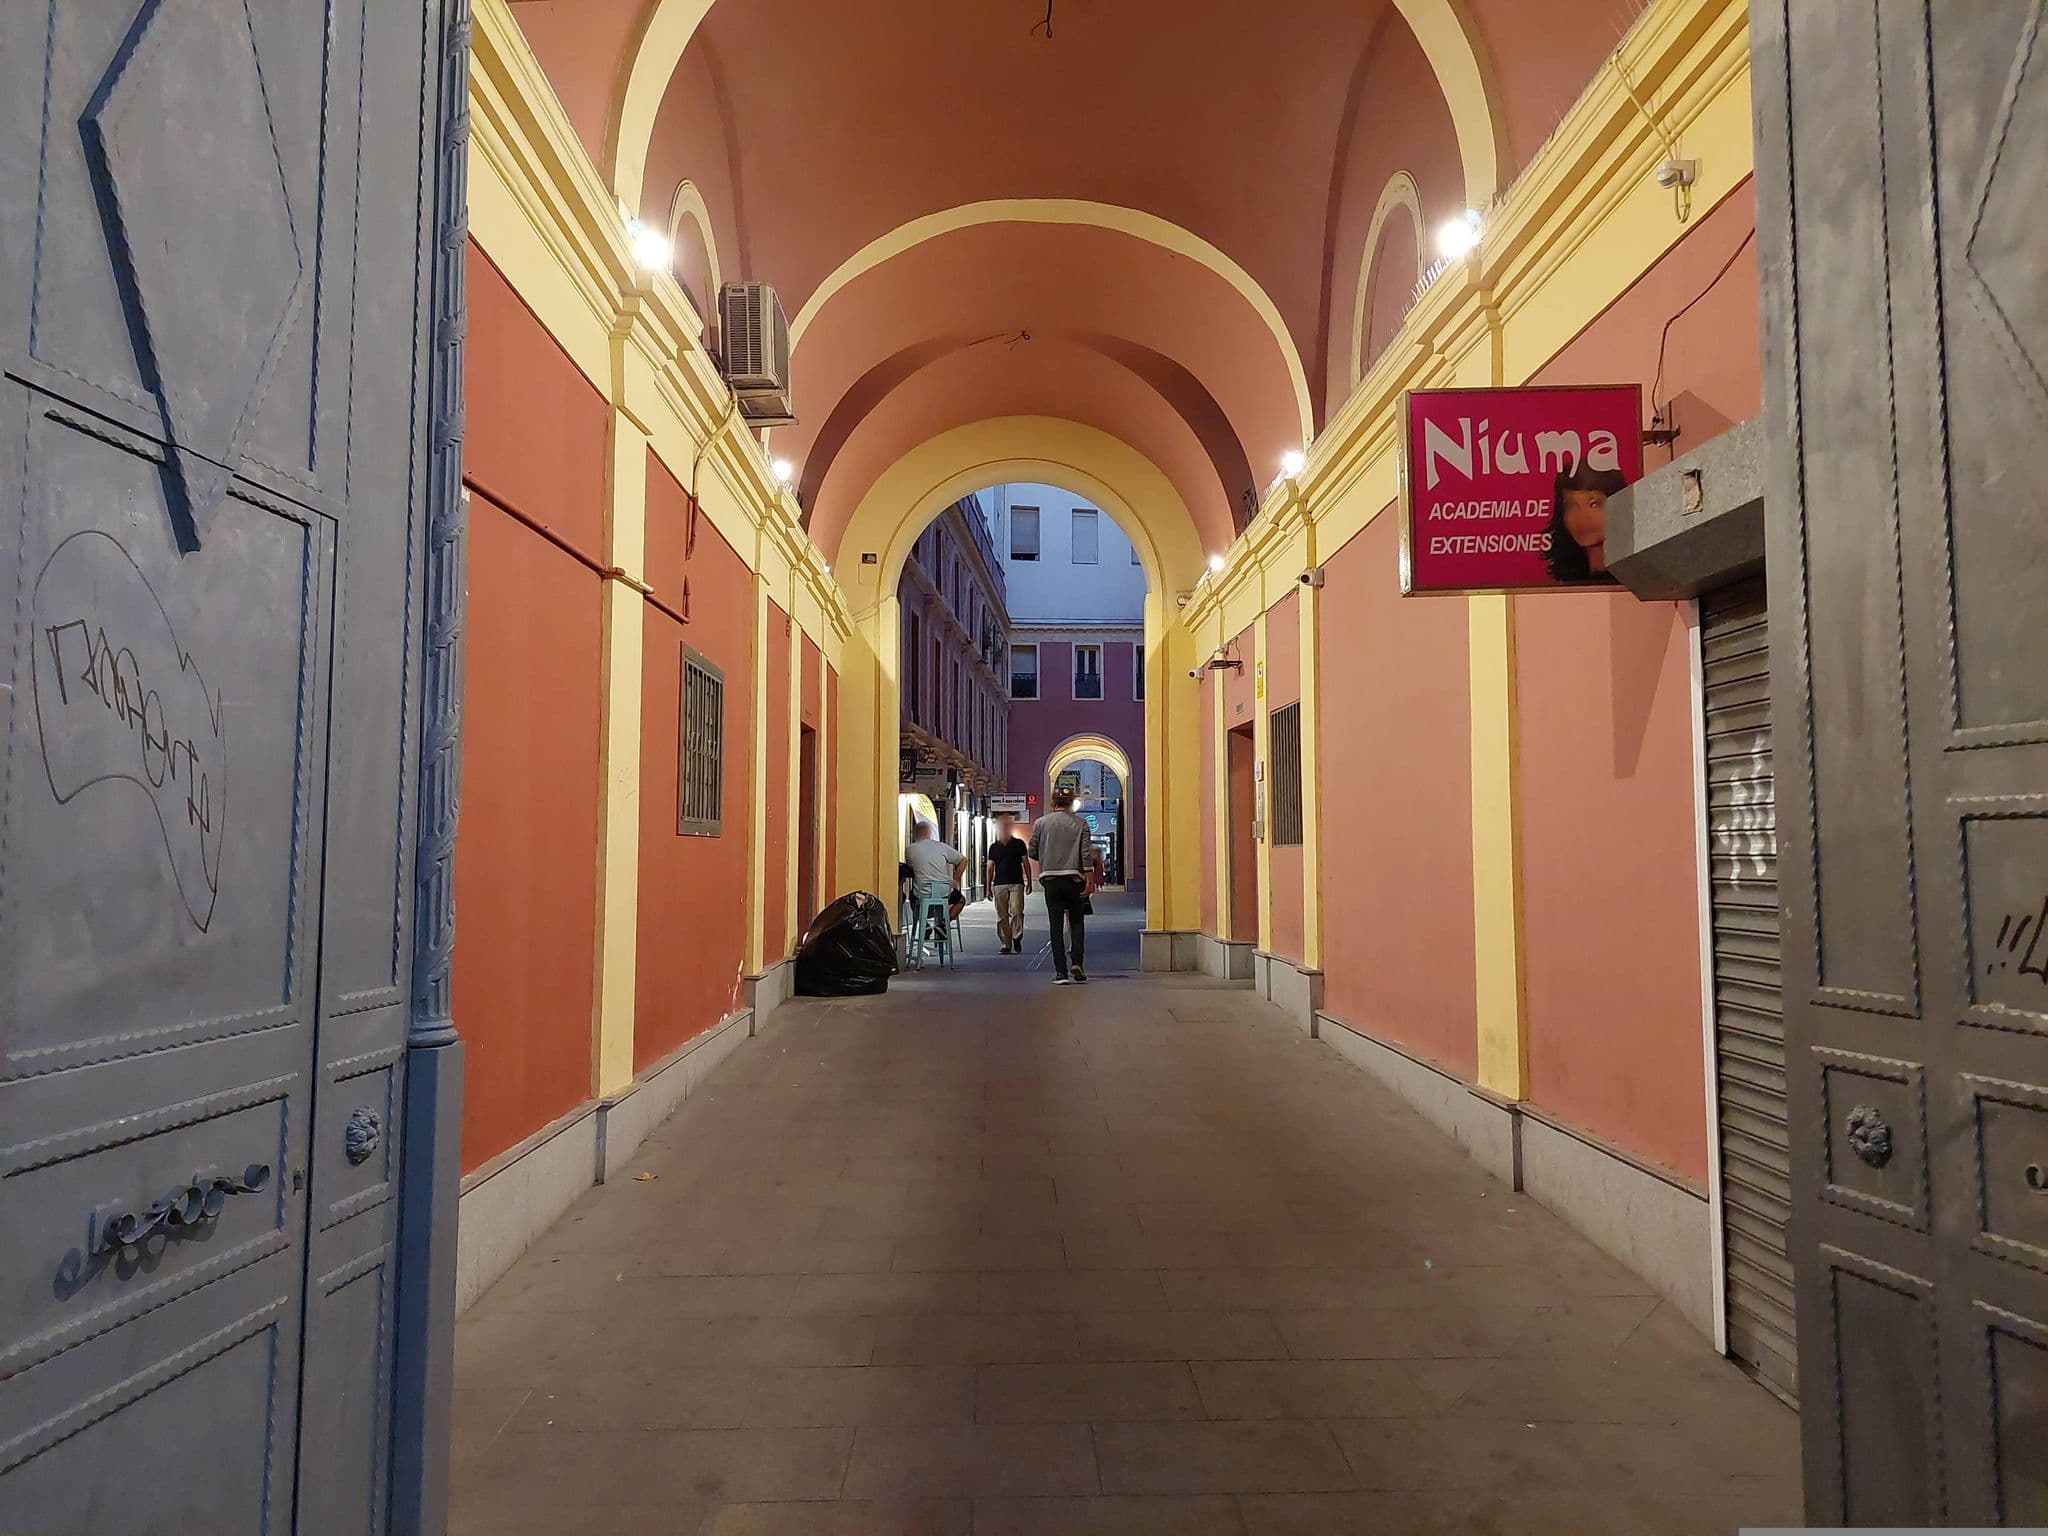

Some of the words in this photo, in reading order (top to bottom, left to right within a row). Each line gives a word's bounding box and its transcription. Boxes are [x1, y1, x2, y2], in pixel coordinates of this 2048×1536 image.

[1424, 417, 1621, 491] Niuma
[1429, 500, 1522, 520] ACADEMIA
[1525, 499, 1550, 518] DE
[1429, 533, 1553, 555] EXTENSIONES
